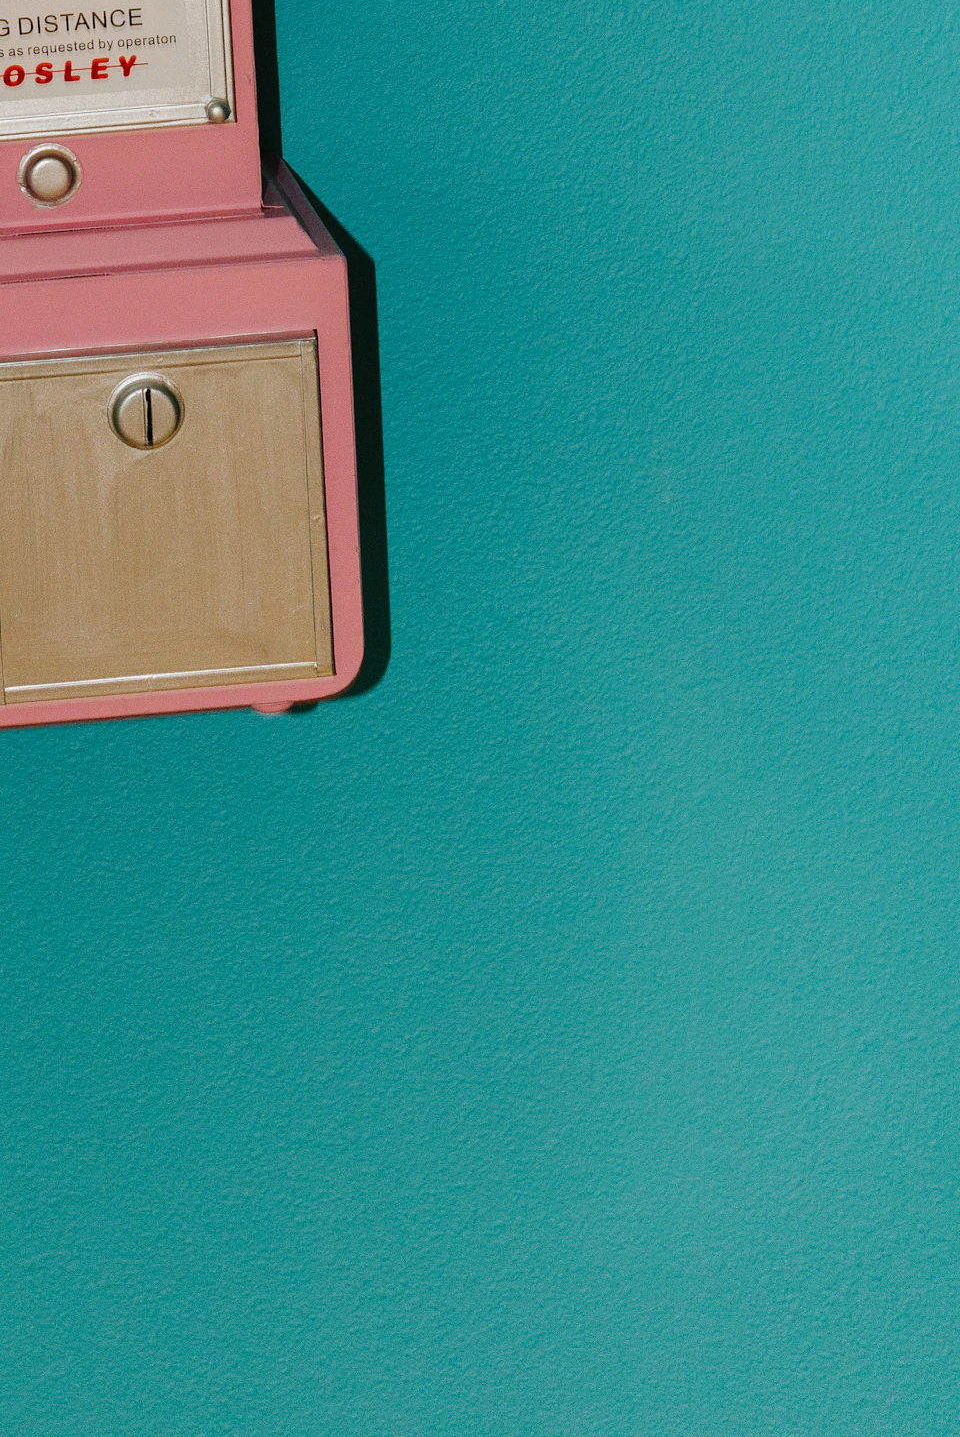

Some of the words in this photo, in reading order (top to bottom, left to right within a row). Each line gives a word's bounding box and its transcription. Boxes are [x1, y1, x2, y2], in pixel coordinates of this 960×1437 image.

[19, 8, 144, 36] DISTANCE
[8, 46, 24, 58] as
[27, 38, 94, 58] requested
[98, 36, 113, 52] by
[117, 34, 176, 50] operaton
